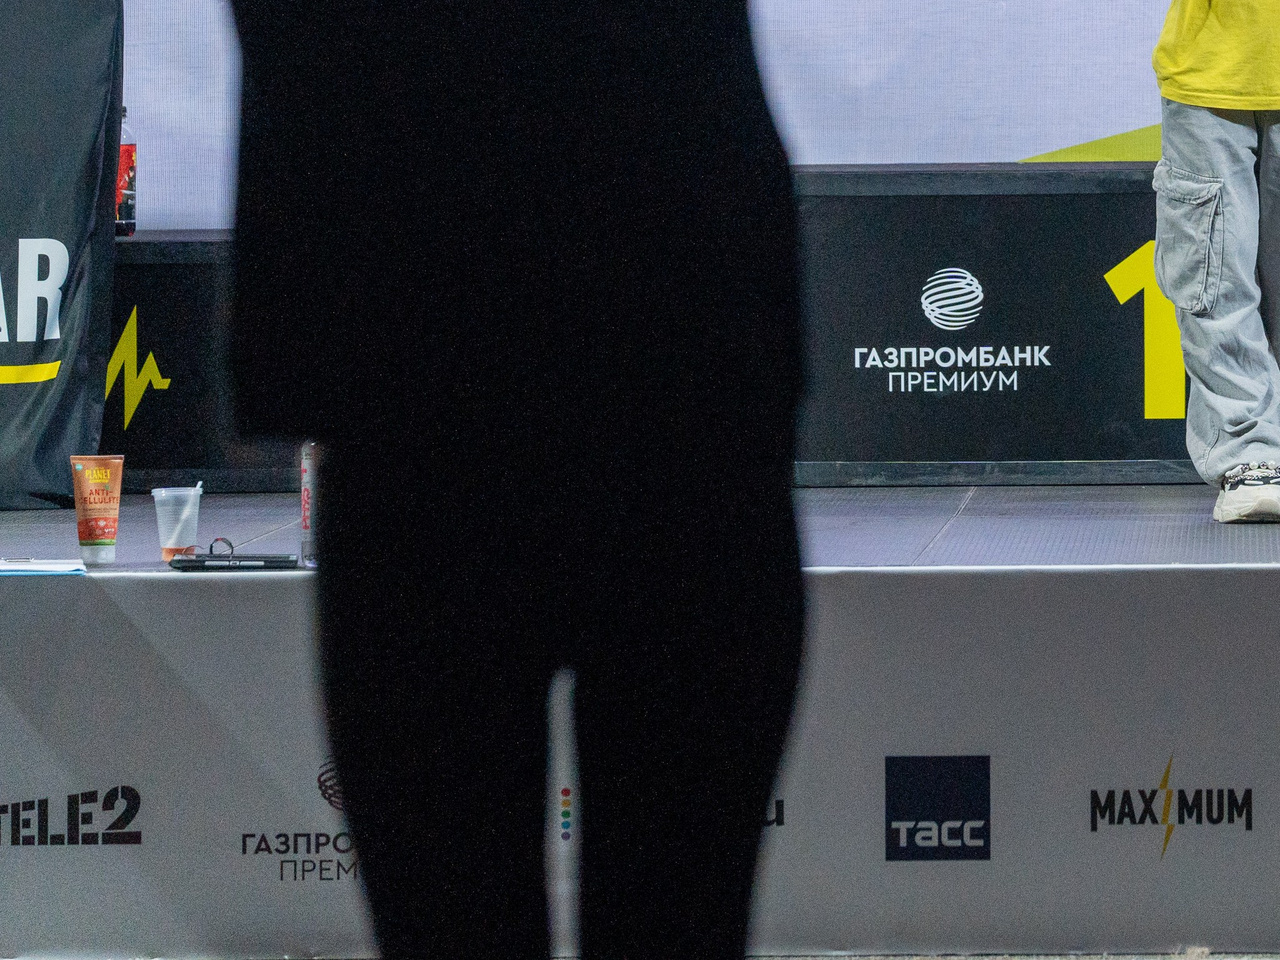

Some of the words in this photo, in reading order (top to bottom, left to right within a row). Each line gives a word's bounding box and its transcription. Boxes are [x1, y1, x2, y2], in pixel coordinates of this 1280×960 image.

[1104, 240, 1186, 419] 1
[854, 346, 1052, 368] ГАЗПРОМБАНК
[888, 371, 1018, 392] ПРЕМИУМ
